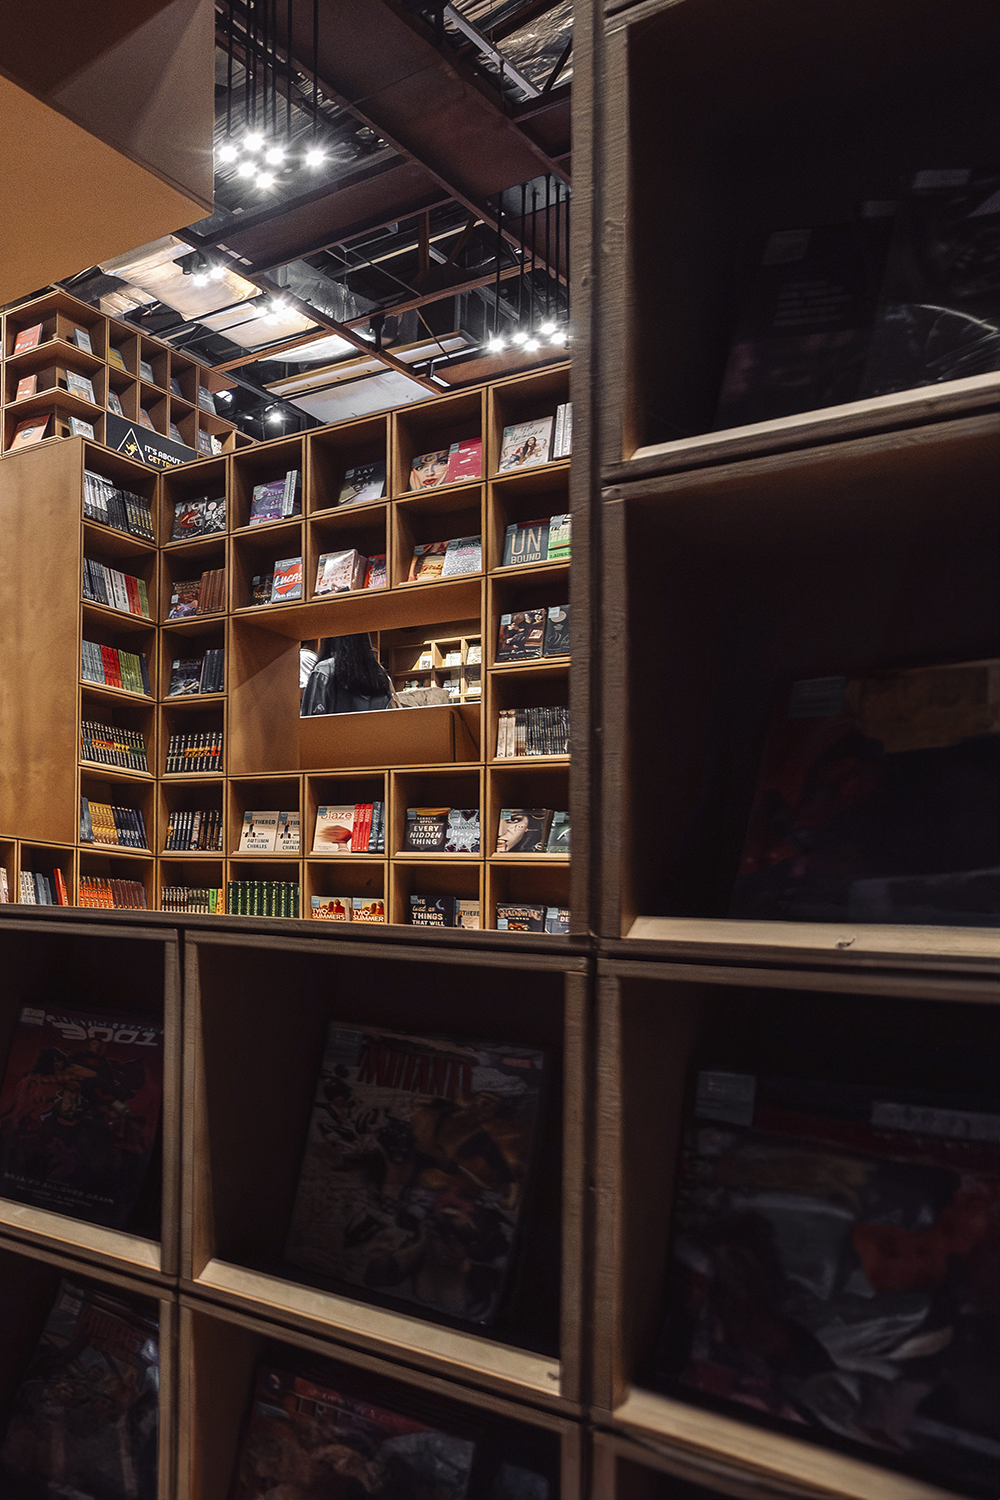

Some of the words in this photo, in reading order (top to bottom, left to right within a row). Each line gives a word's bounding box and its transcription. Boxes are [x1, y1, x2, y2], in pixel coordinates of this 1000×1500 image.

[158, 451, 181, 465] ABOUT
[511, 526, 542, 556] UN
[510, 552, 542, 565] BOUND
[409, 831, 442, 839] HIDDEN
[412, 912, 444, 921] THINGS
